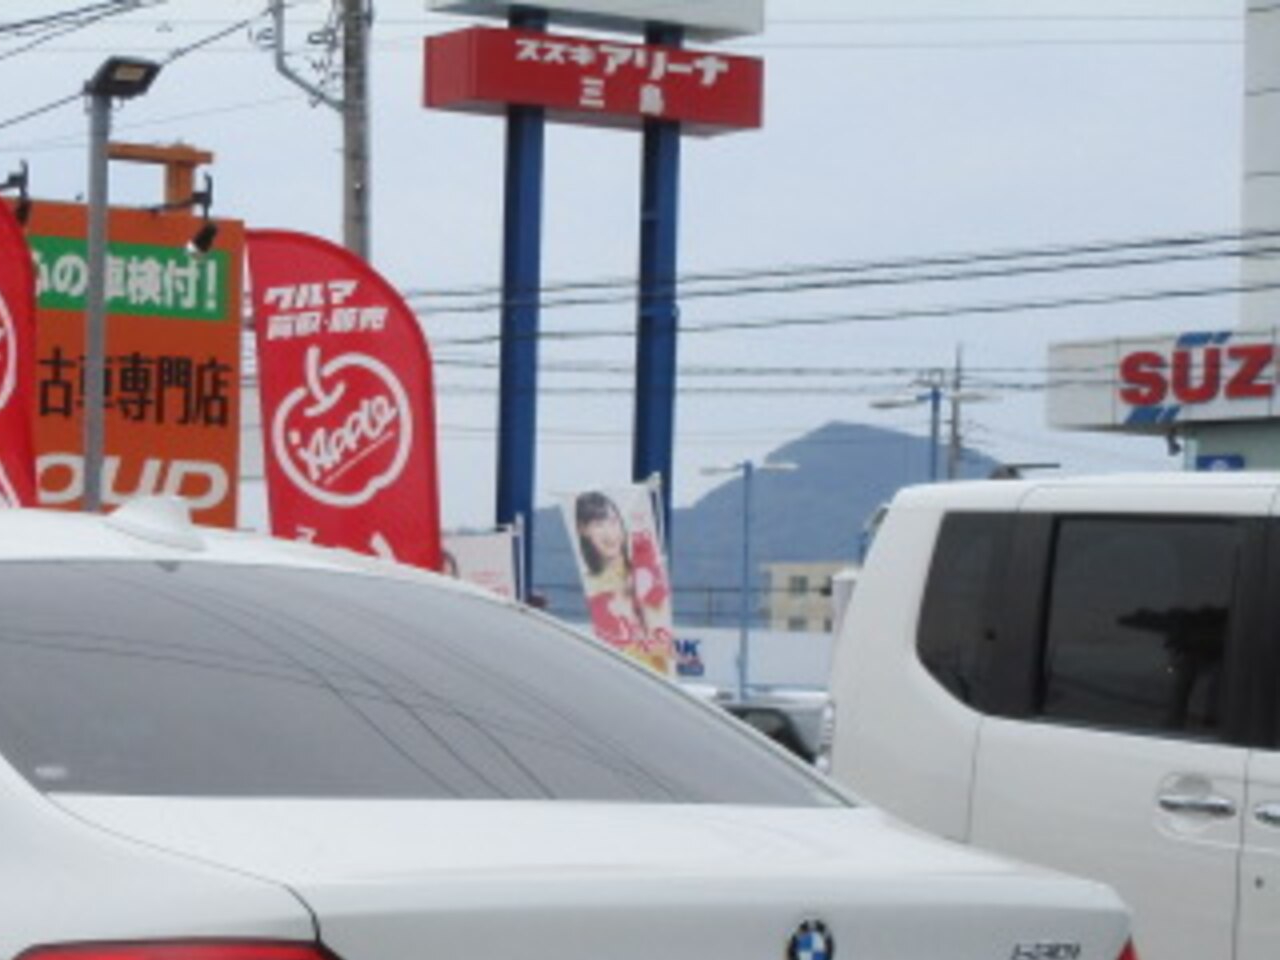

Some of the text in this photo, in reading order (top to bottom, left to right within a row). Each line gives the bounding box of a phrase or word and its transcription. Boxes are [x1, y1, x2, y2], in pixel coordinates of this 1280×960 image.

[514, 39, 729, 87] スズキアリーナ
[264, 279, 358, 311] クルマ
[1120, 344, 1280, 406] SUZ
